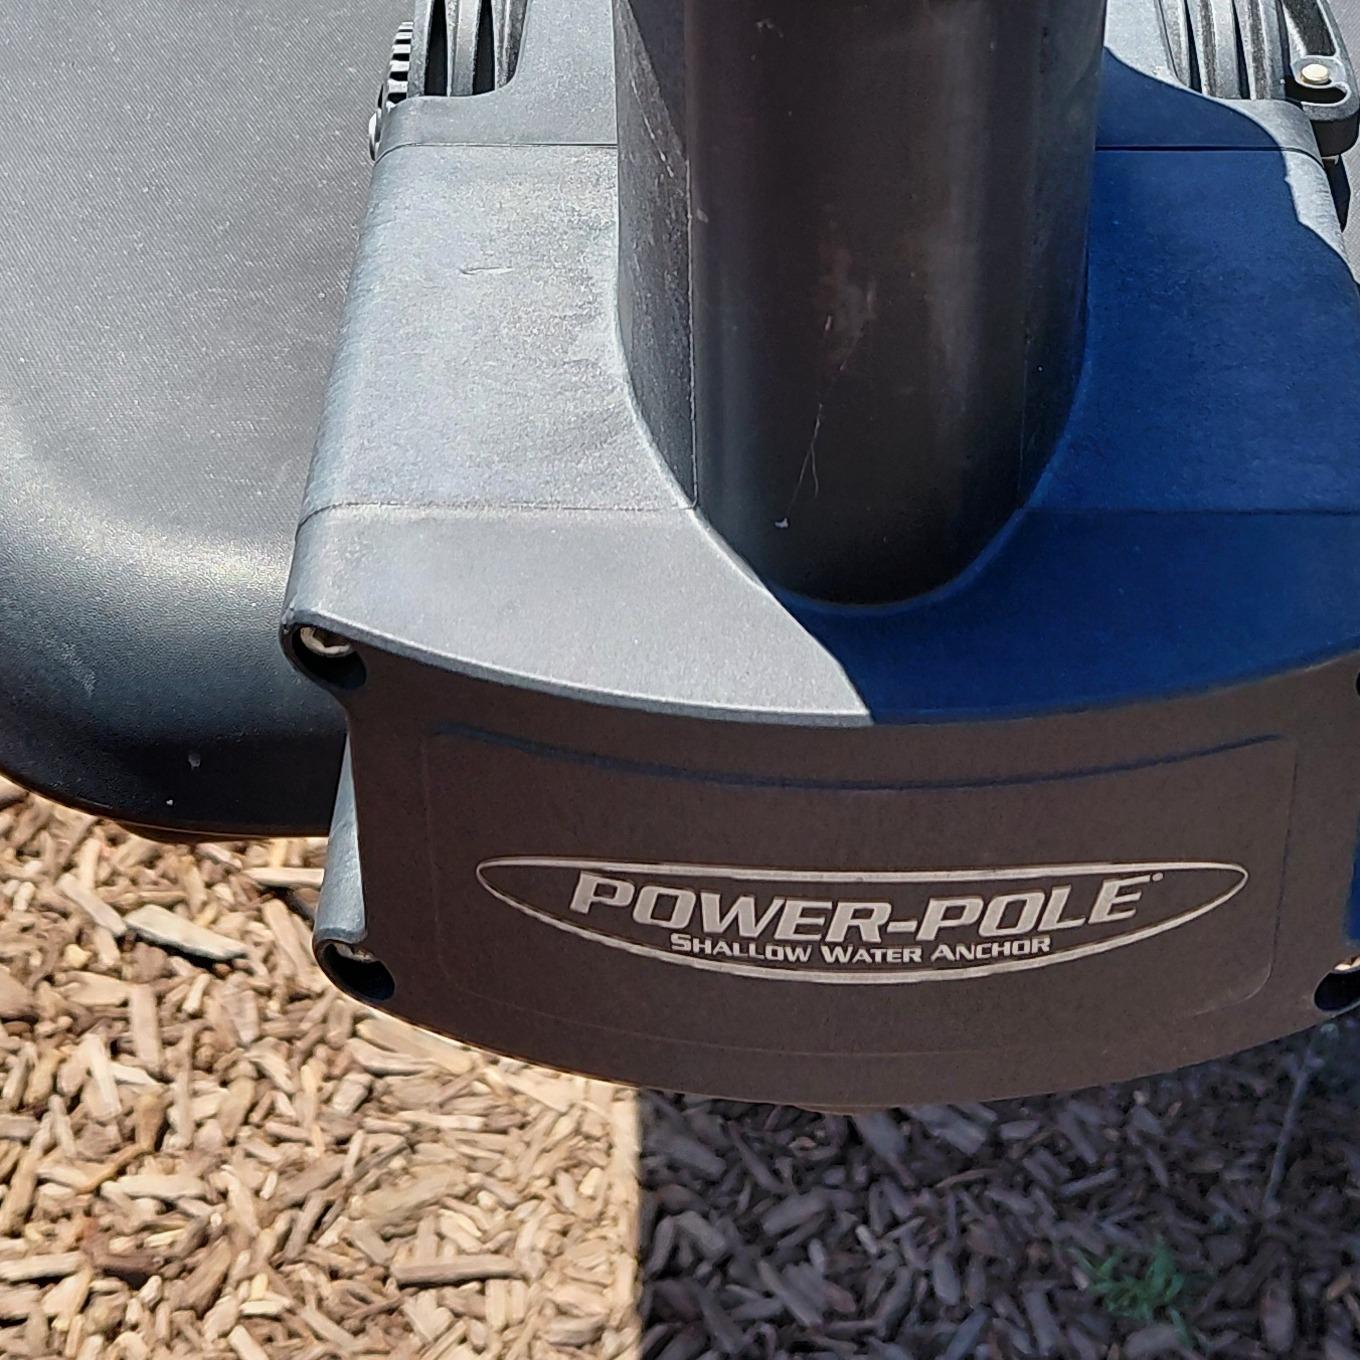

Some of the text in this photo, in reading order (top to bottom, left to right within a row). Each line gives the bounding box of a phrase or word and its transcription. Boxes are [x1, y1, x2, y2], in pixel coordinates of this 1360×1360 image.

[569, 871, 1151, 943] POWER-POLE
[670, 933, 1051, 964] SHALLOW WATER ANCHOR
